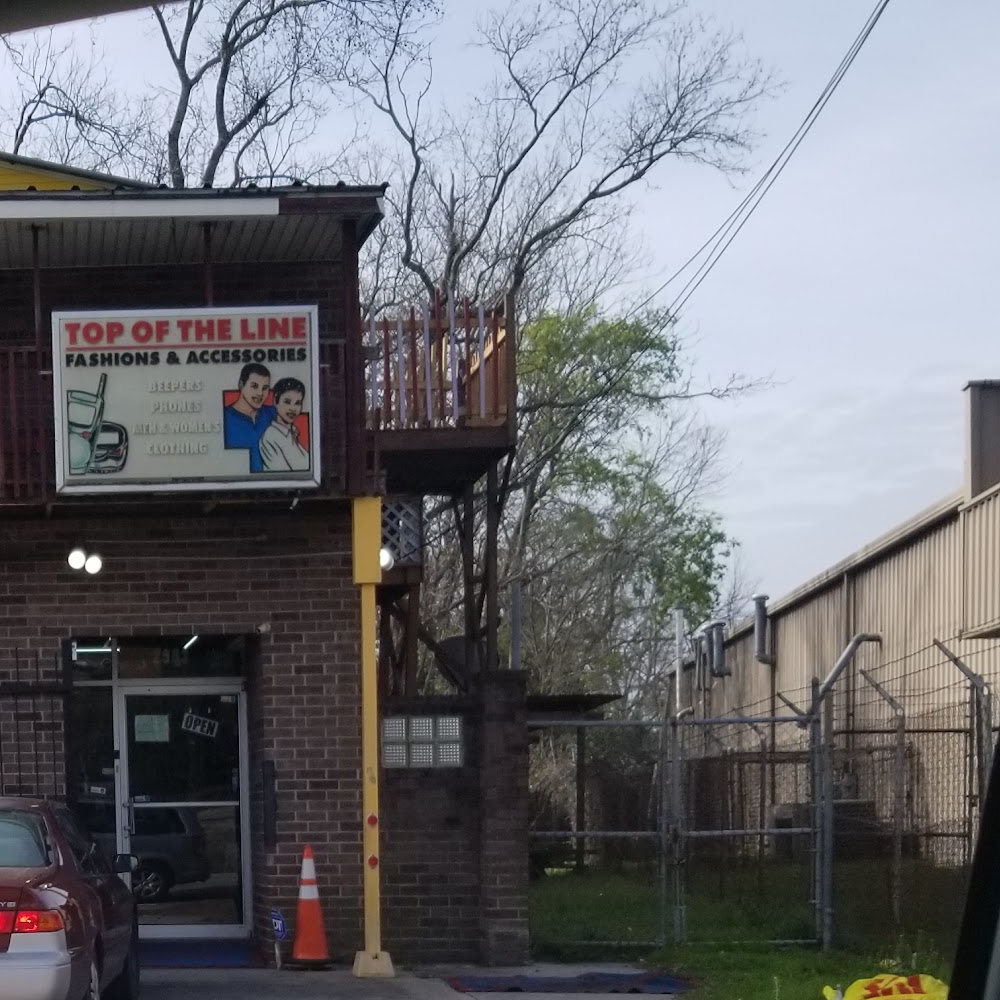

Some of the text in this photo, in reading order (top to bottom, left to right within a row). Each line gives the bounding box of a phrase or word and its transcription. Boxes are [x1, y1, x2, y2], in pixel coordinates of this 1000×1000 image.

[64, 316, 306, 345] TOP OF THE LINE
[66, 348, 307, 367] FASHIONS & ACCESSORIES
[149, 380, 203, 393] BEEPERS
[152, 401, 201, 414] PHONES
[132, 422, 160, 435] MEN
[147, 442, 209, 456] CLOTHING
[184, 714, 216, 737] OPEN
